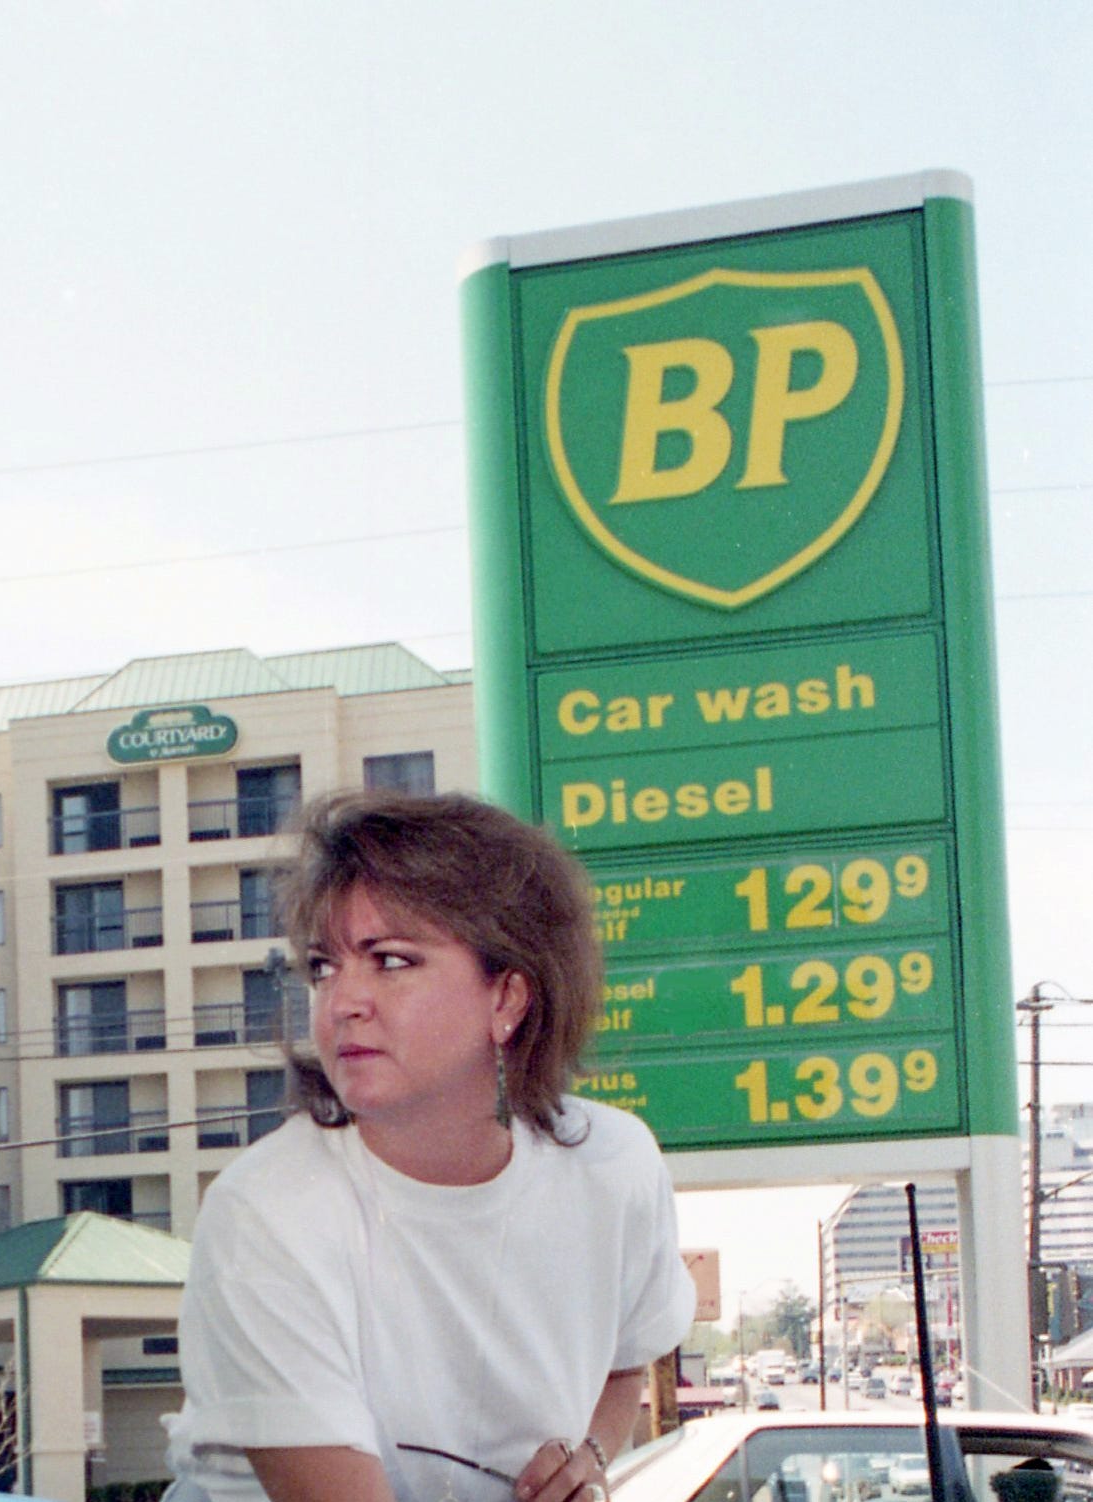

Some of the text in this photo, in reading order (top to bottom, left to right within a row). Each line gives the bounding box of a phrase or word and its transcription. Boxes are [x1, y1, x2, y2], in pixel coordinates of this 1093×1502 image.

[608, 320, 859, 505] BP
[559, 664, 875, 735] Car wash
[119, 724, 226, 749] COURTYARD
[562, 766, 772, 828] Diesel
[592, 877, 684, 906] egular
[595, 1009, 633, 1030] elf
